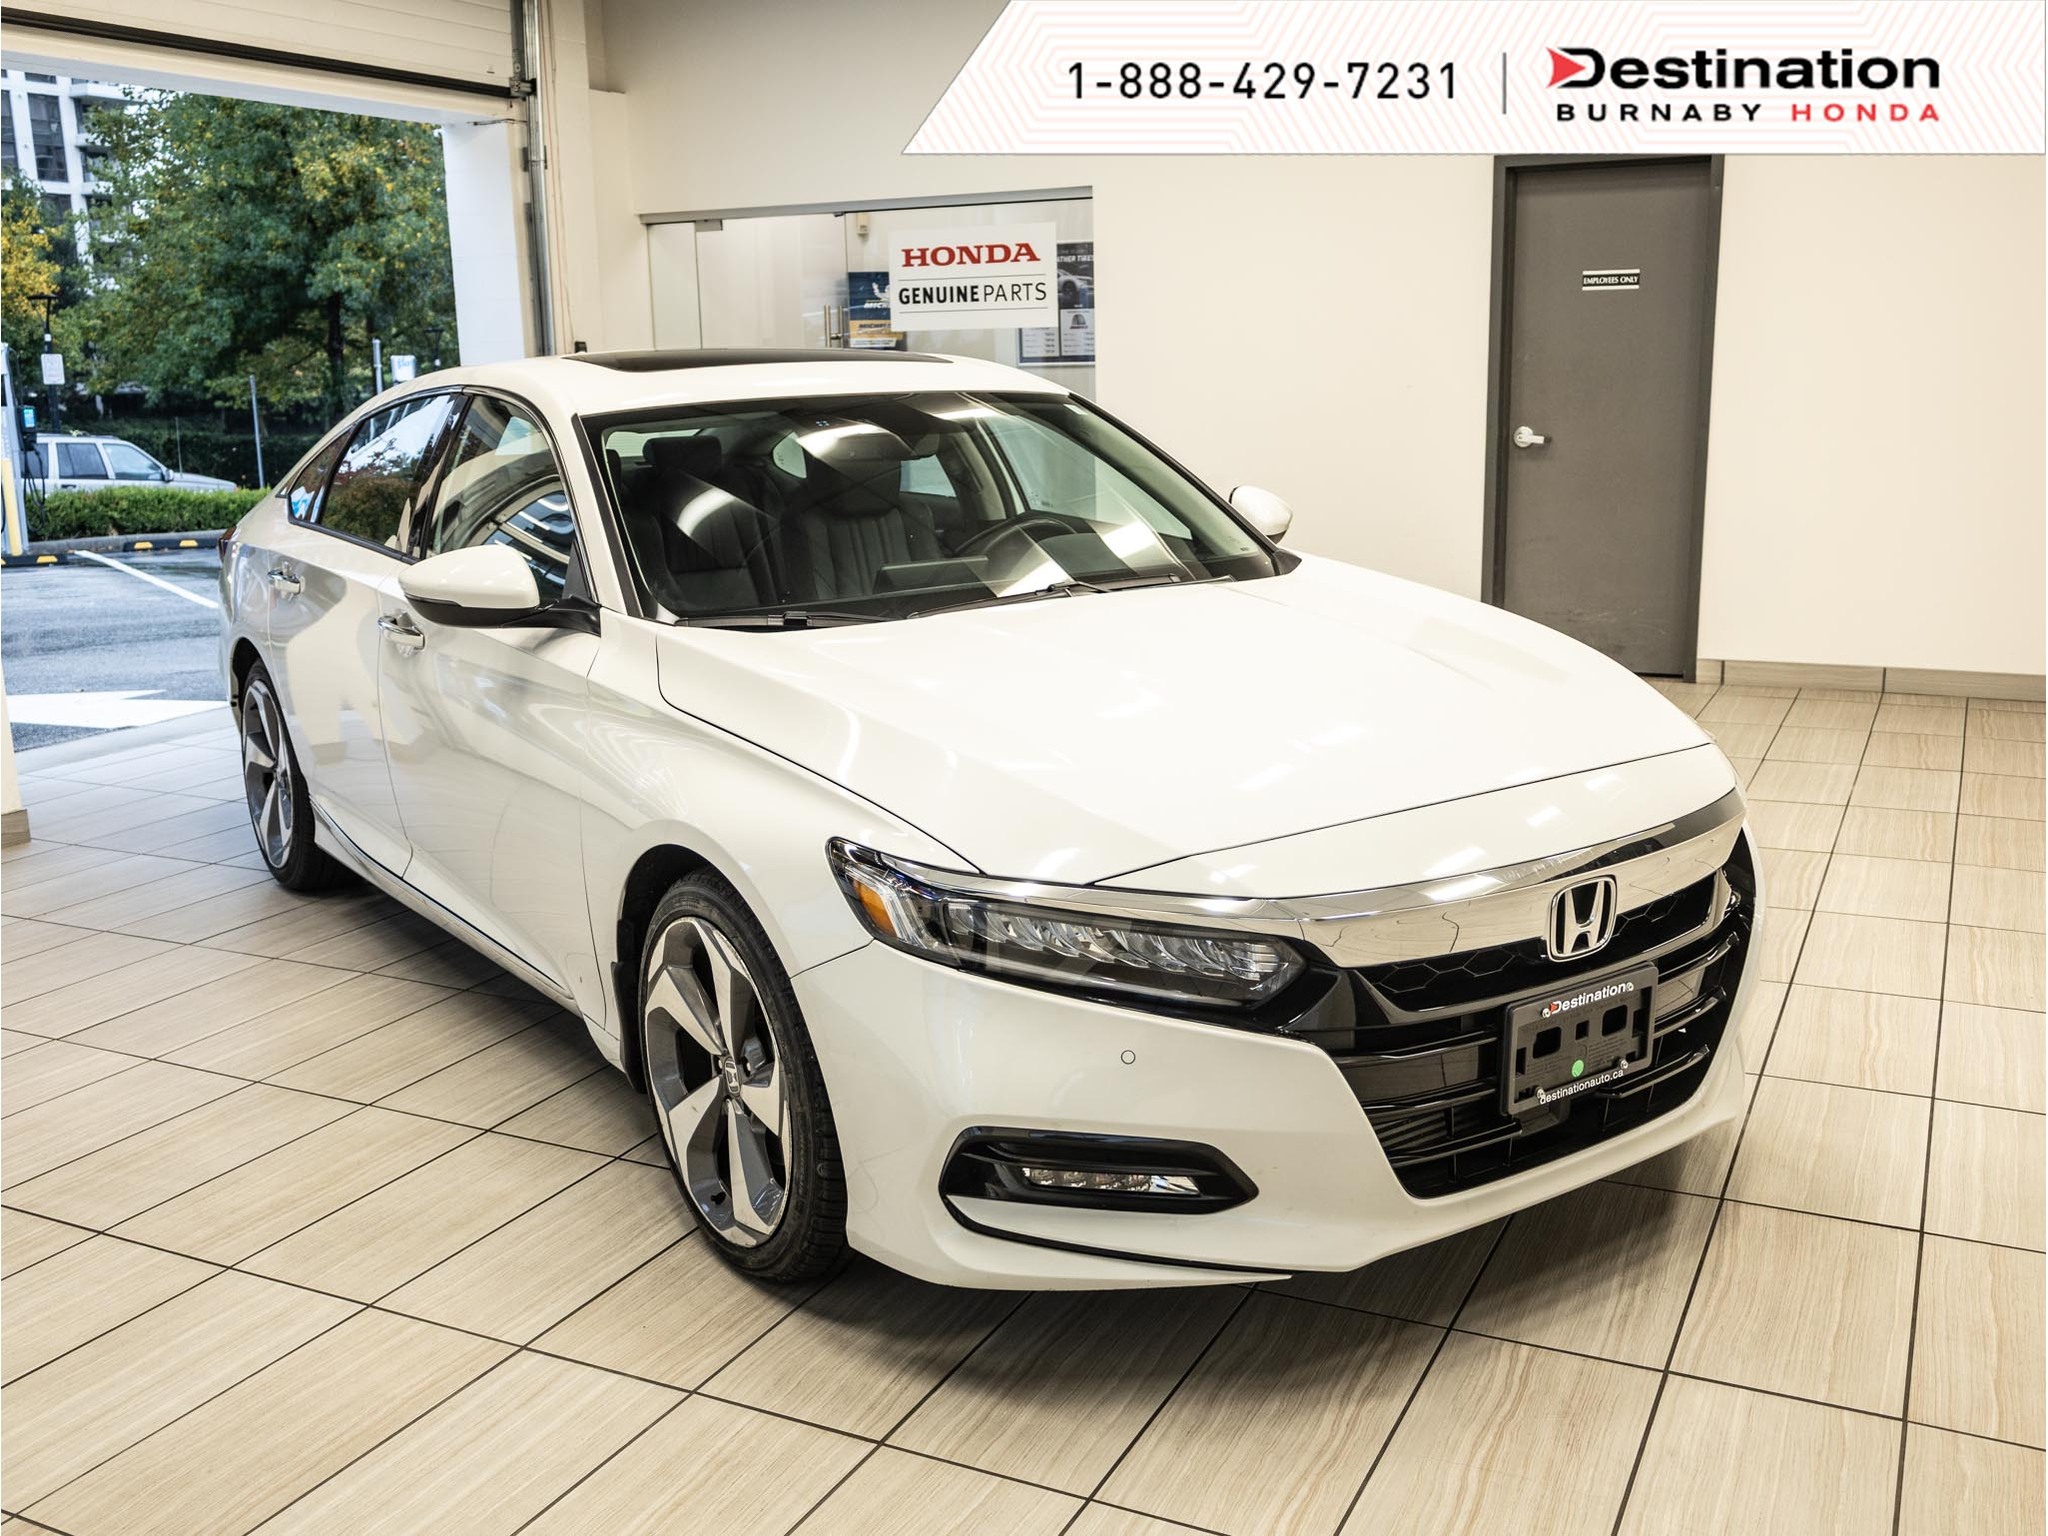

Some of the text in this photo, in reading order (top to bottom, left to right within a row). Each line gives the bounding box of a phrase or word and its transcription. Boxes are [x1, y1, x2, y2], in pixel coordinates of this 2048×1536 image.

[901, 242, 1041, 268] HONDA
[1583, 275, 1639, 285] EMPLOYEES ONLY
[899, 282, 1047, 305] GENUINE PARTS
[1550, 983, 1626, 1015] Destination
[1540, 1069, 1624, 1105] destinationauto.ca
